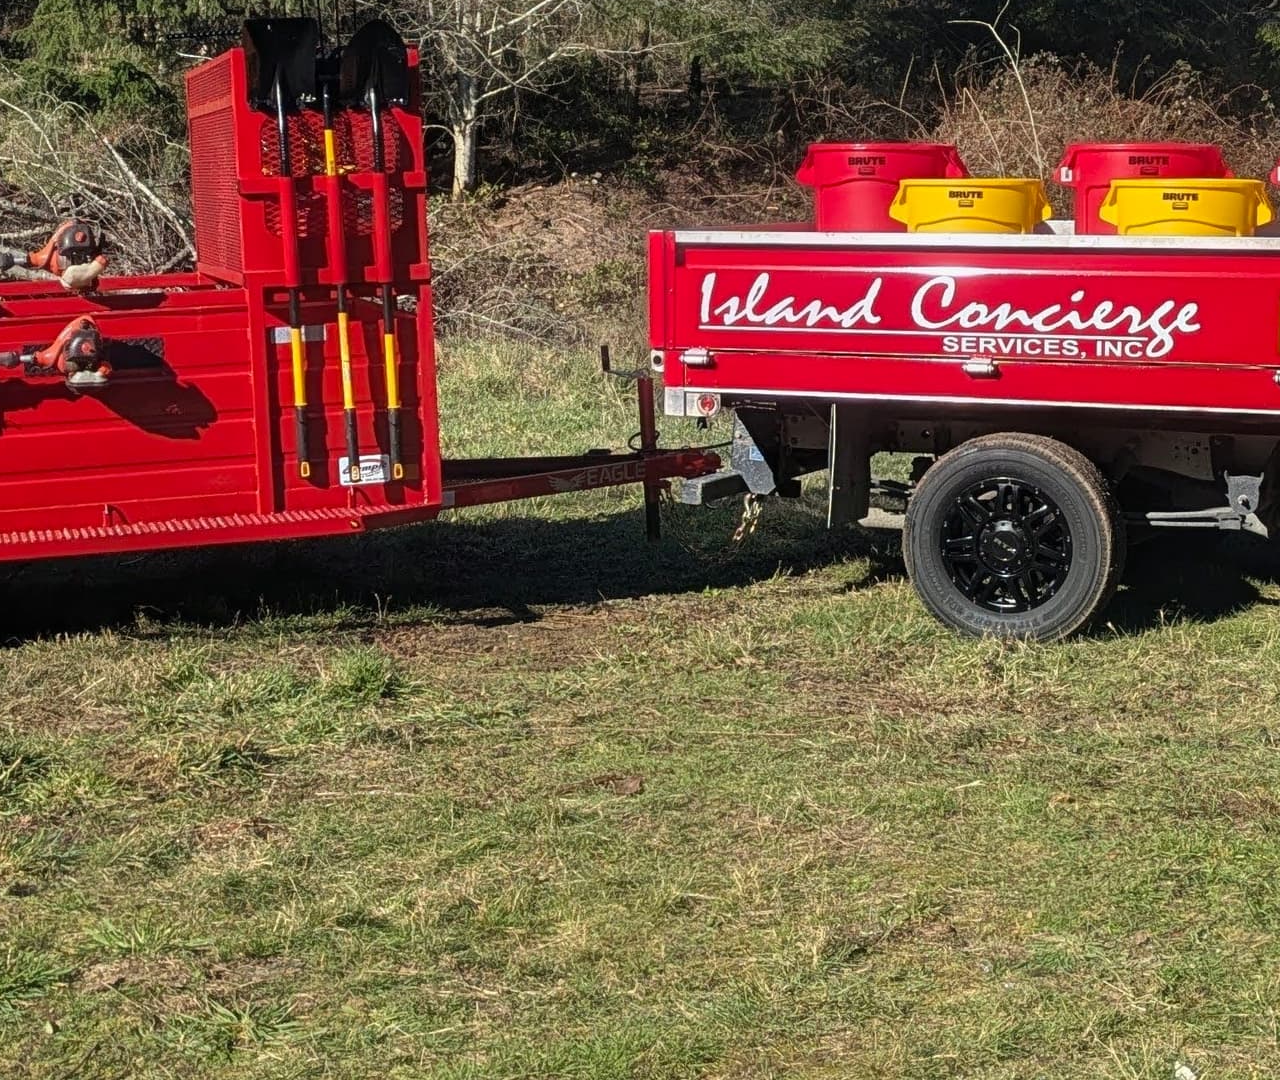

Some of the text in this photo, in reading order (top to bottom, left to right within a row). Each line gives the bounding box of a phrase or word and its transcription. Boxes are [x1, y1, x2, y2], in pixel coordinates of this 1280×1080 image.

[848, 156, 886, 166] BRUTE
[1127, 156, 1170, 165] BRUTE
[948, 190, 984, 199] BRUTE
[1162, 192, 1199, 201] BRUTE
[699, 271, 1202, 358] Island Concierge
[942, 336, 1145, 358] SERVICES, INC
[586, 462, 647, 486] EAGLE
